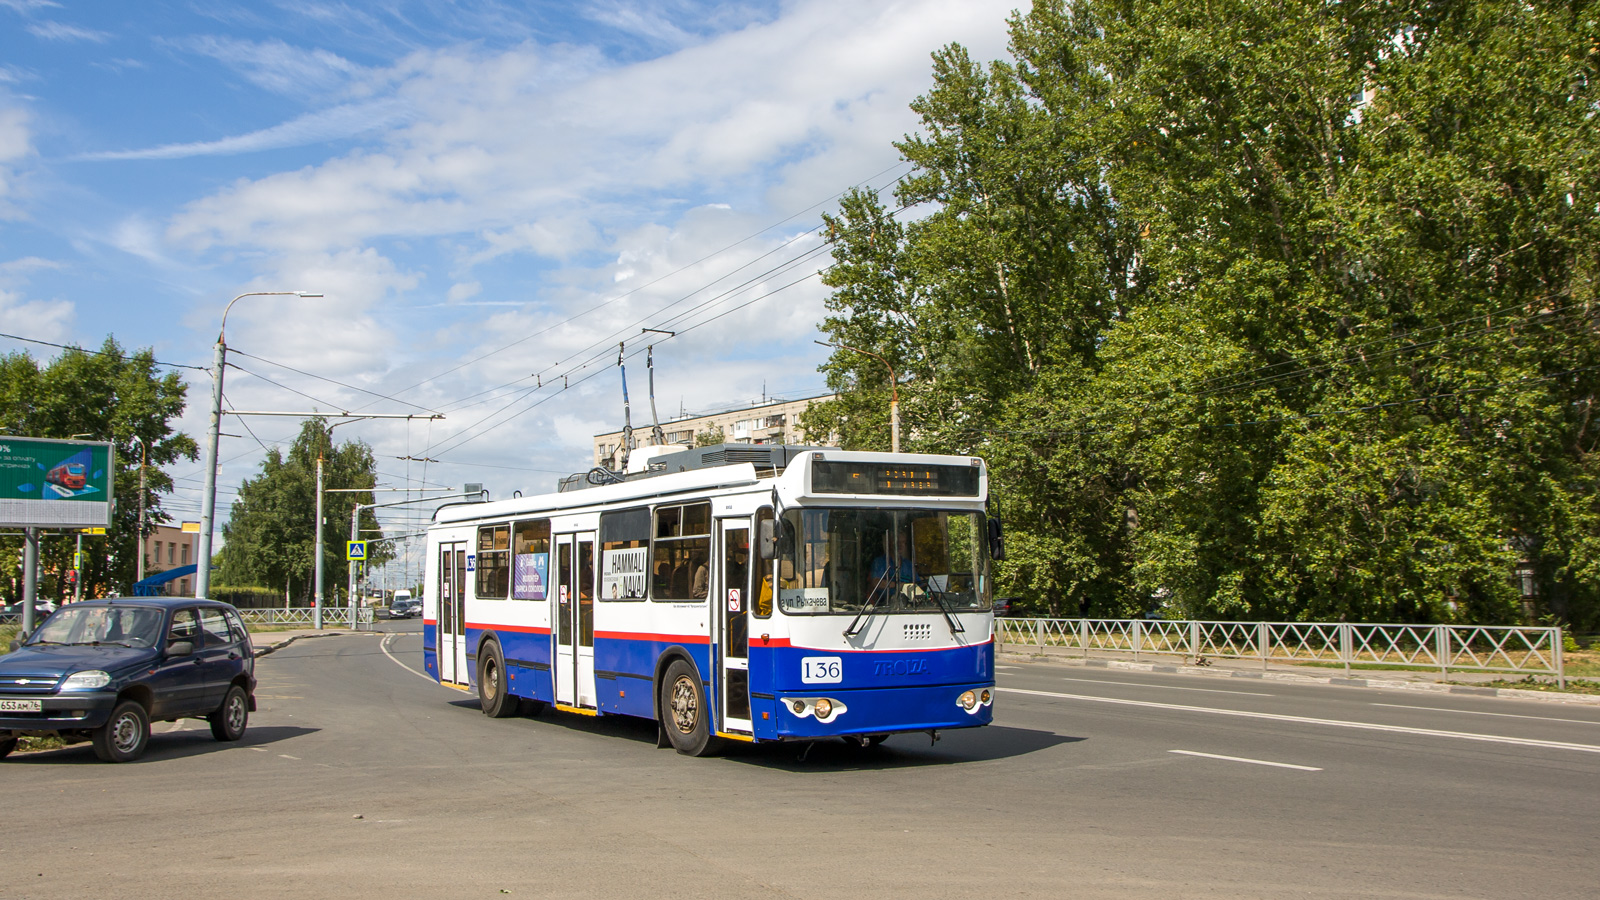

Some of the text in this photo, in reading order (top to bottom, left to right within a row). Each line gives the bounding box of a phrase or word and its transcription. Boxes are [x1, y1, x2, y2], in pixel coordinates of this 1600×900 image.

[612, 552, 644, 574] HAMMALI
[805, 662, 840, 678] 136
[874, 659, 929, 675] TROLZA
